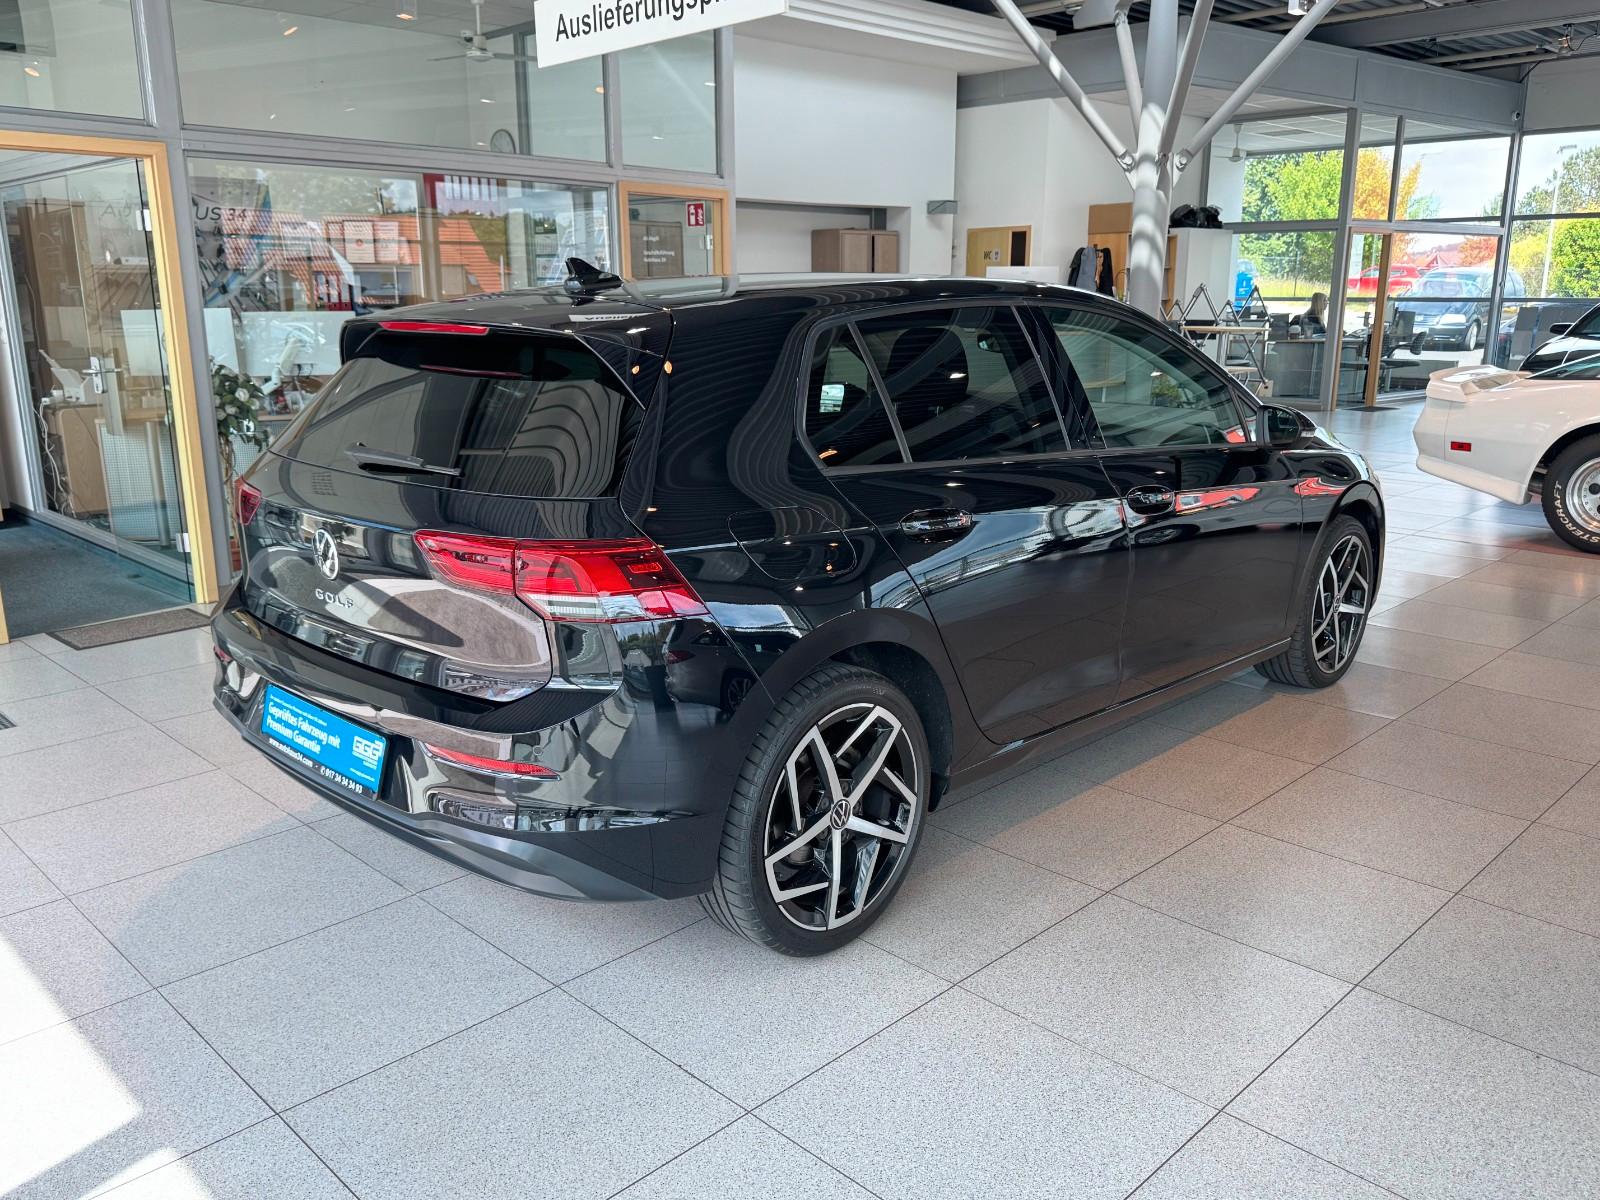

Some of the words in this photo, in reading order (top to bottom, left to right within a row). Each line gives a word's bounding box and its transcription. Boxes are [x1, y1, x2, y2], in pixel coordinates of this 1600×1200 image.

[266, 715, 293, 740] Premium
[293, 730, 321, 755] Garantie
[268, 701, 299, 728] Geprüftes
[298, 717, 328, 745] Fahrzeug
[328, 734, 341, 749] mit
